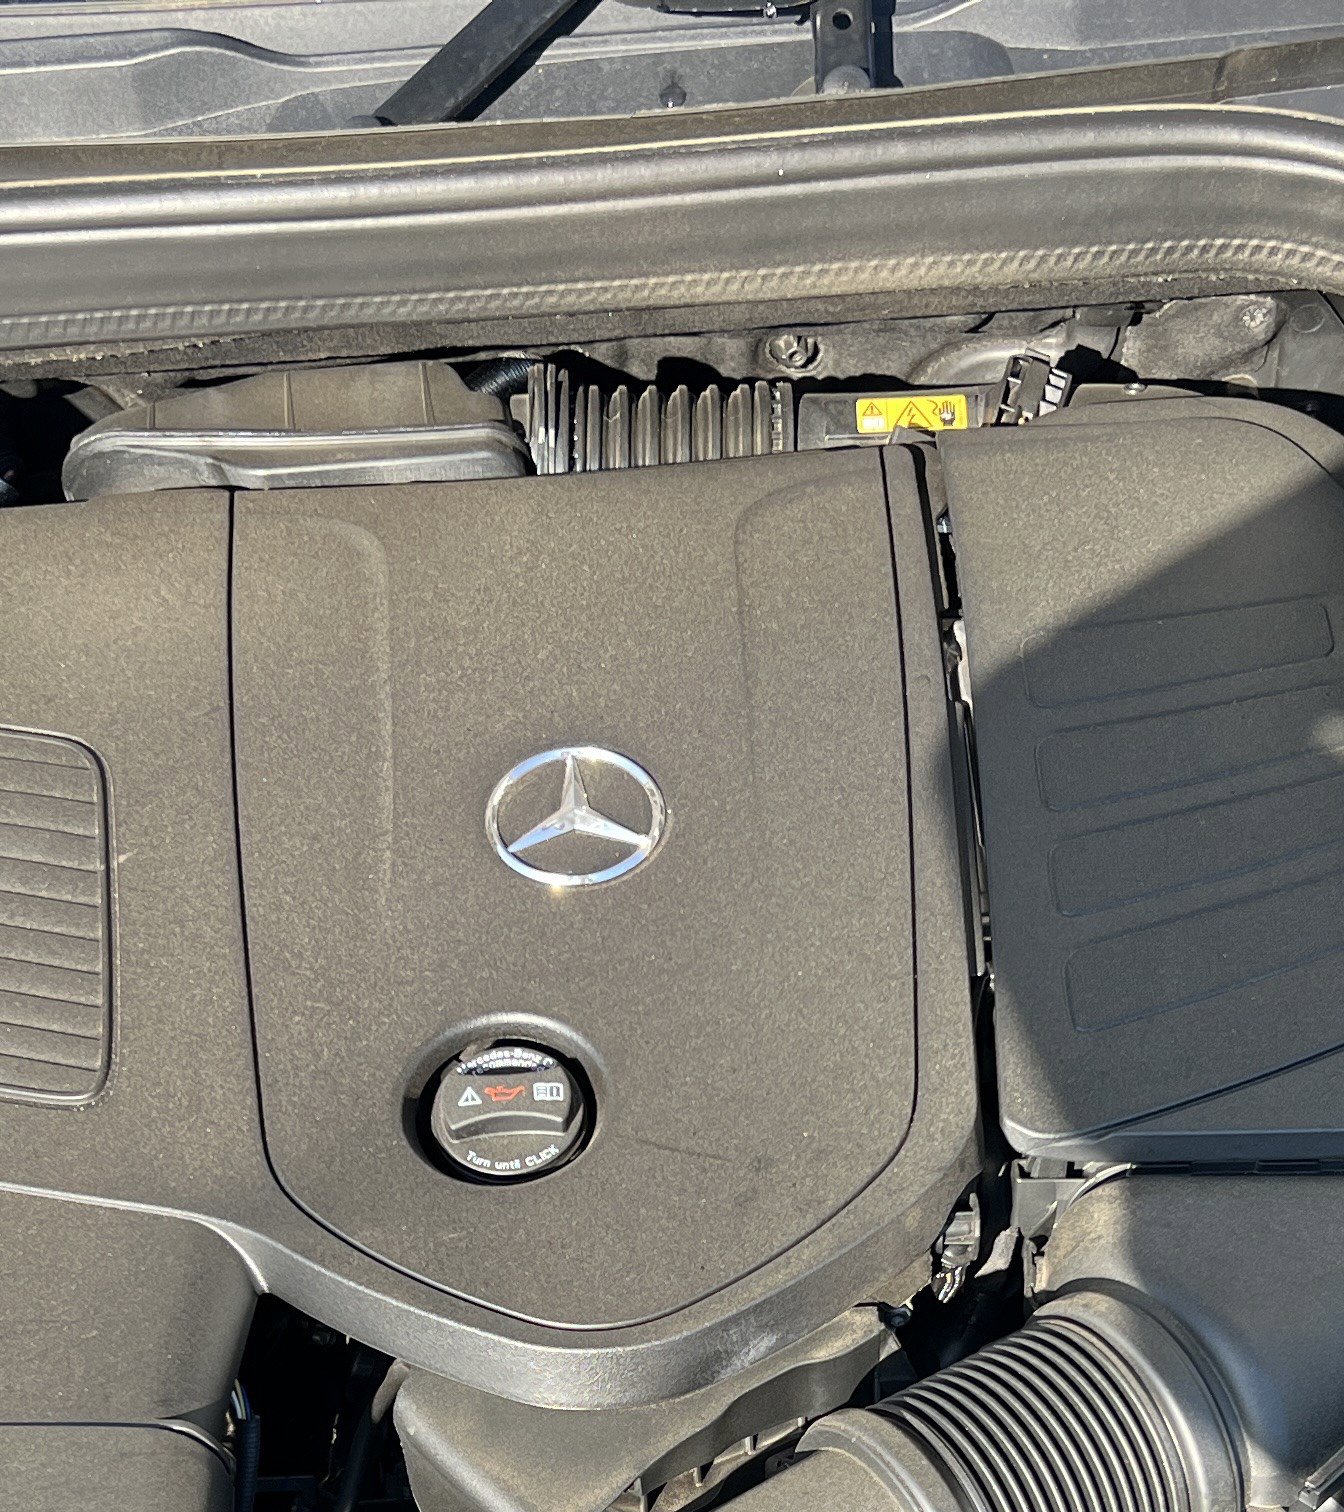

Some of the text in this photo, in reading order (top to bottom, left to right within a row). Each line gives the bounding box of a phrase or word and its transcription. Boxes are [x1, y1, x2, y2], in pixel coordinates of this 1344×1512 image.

[467, 1144, 559, 1170] Turn until CLICK
